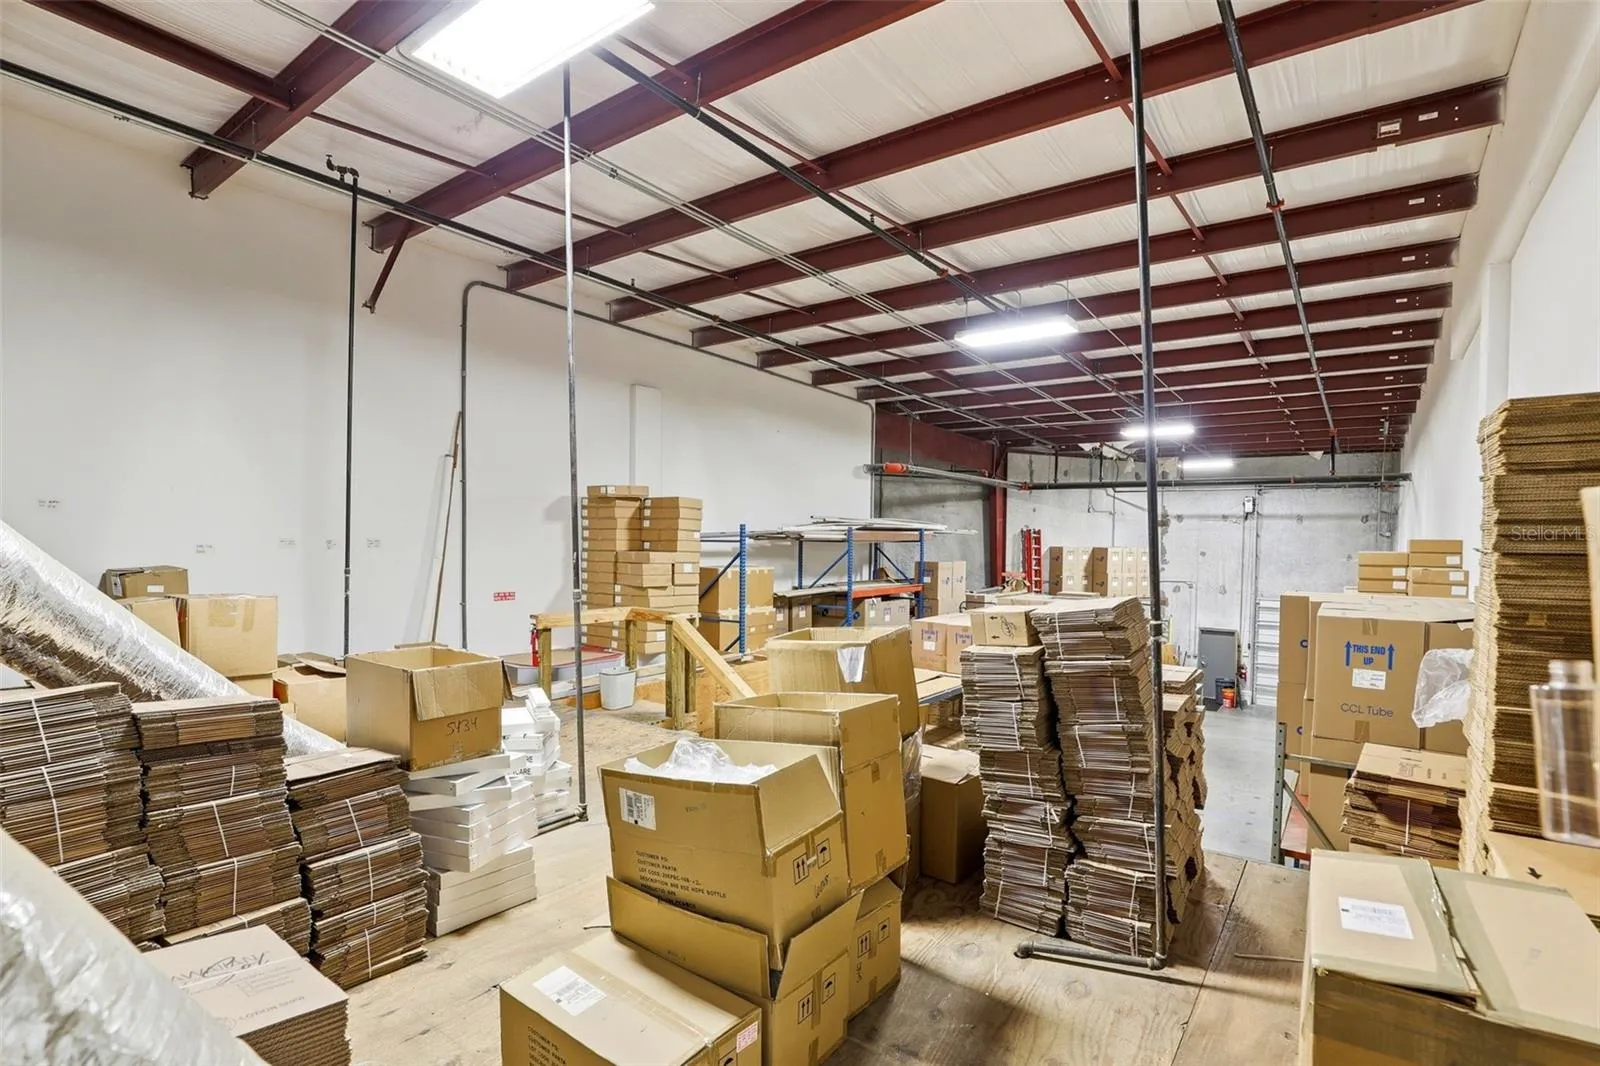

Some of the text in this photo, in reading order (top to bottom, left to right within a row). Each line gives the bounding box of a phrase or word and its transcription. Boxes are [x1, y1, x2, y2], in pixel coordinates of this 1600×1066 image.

[1353, 644, 1386, 655] THIS END
[1363, 657, 1374, 665] UP
[1340, 703, 1394, 717] CCL Tube
[637, 859, 660, 869] CUSTOMER
[706, 889, 727, 899] BOTTLE
